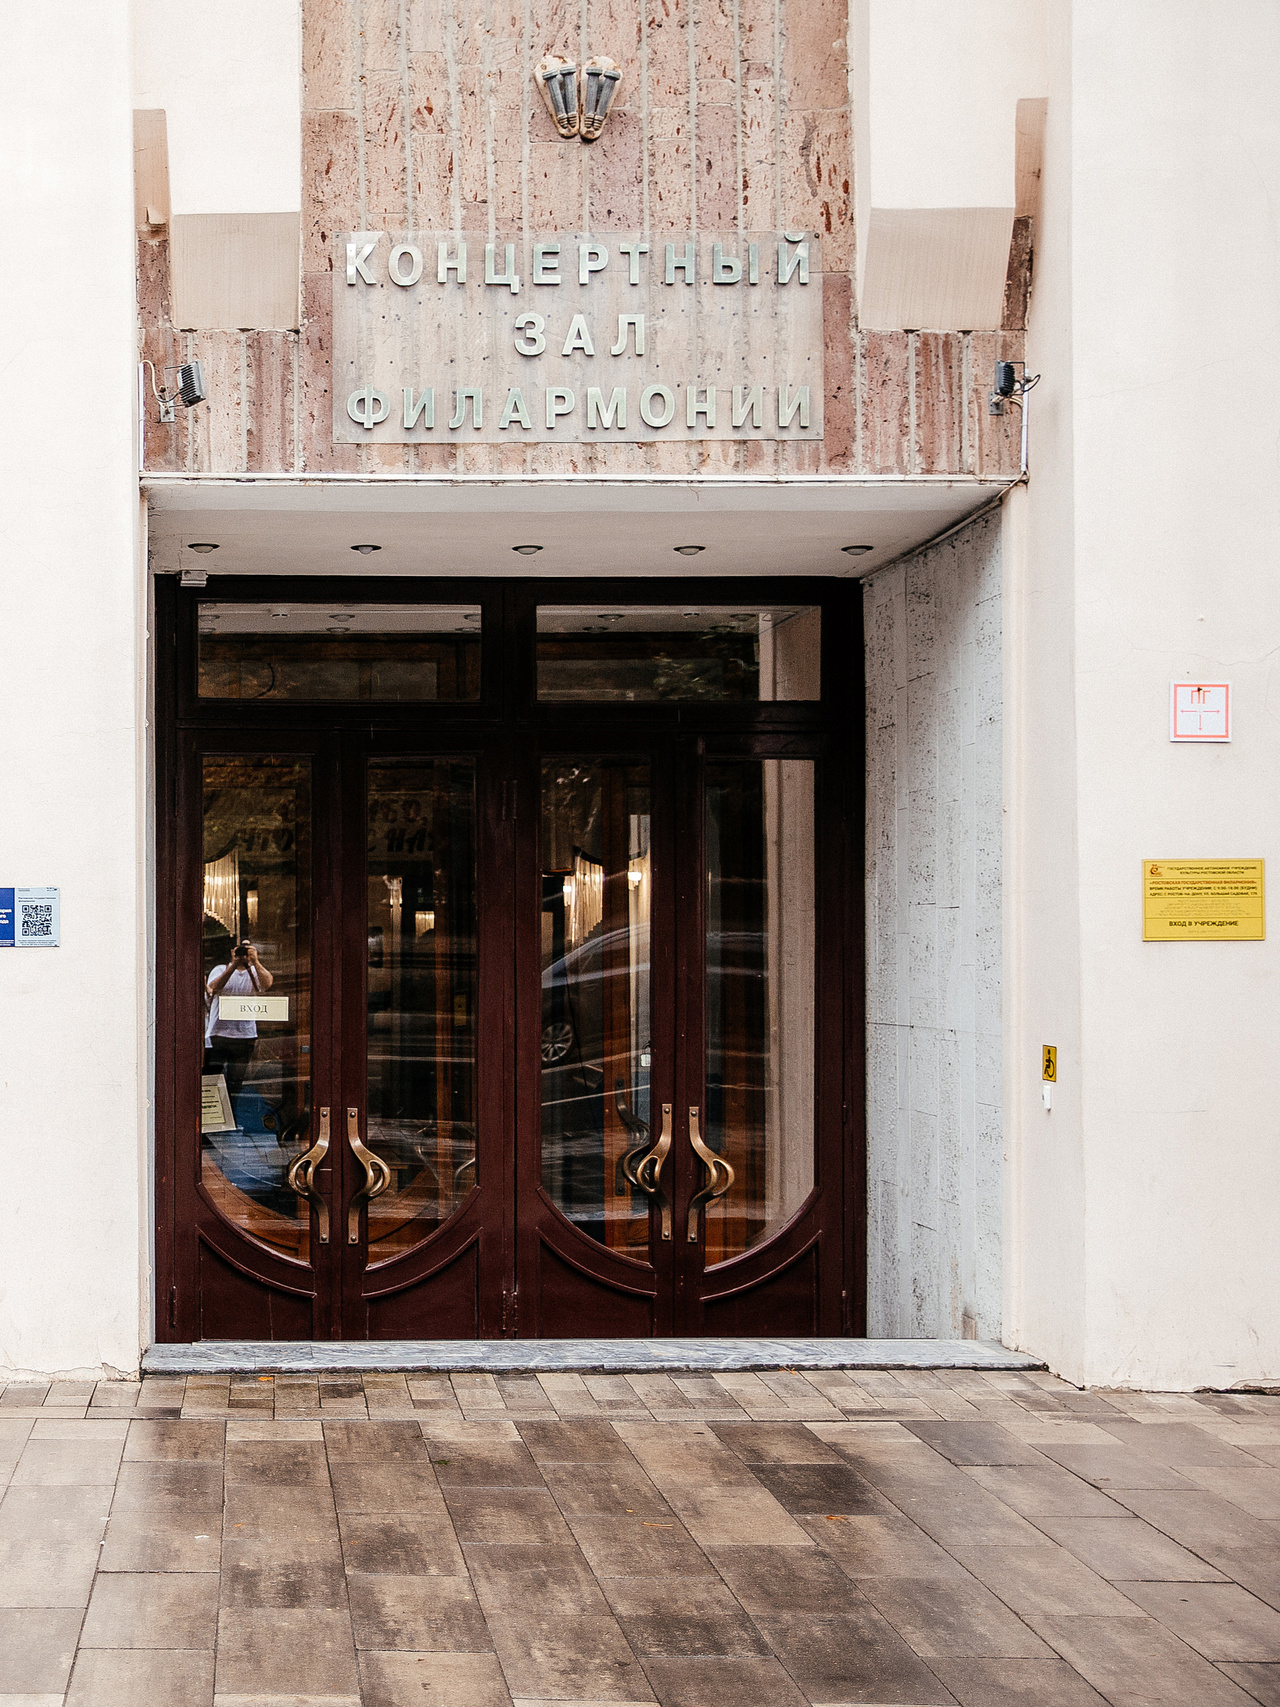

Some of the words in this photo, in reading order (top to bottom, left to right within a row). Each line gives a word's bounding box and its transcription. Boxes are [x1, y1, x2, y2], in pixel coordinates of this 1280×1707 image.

[346, 232, 810, 294] КОНЦЕРТНЫЙ
[514, 312, 645, 356] ЗАЛ
[346, 384, 810, 430] ФИЛАРМОНИИ
[240, 1005, 268, 1013] ВХОД
